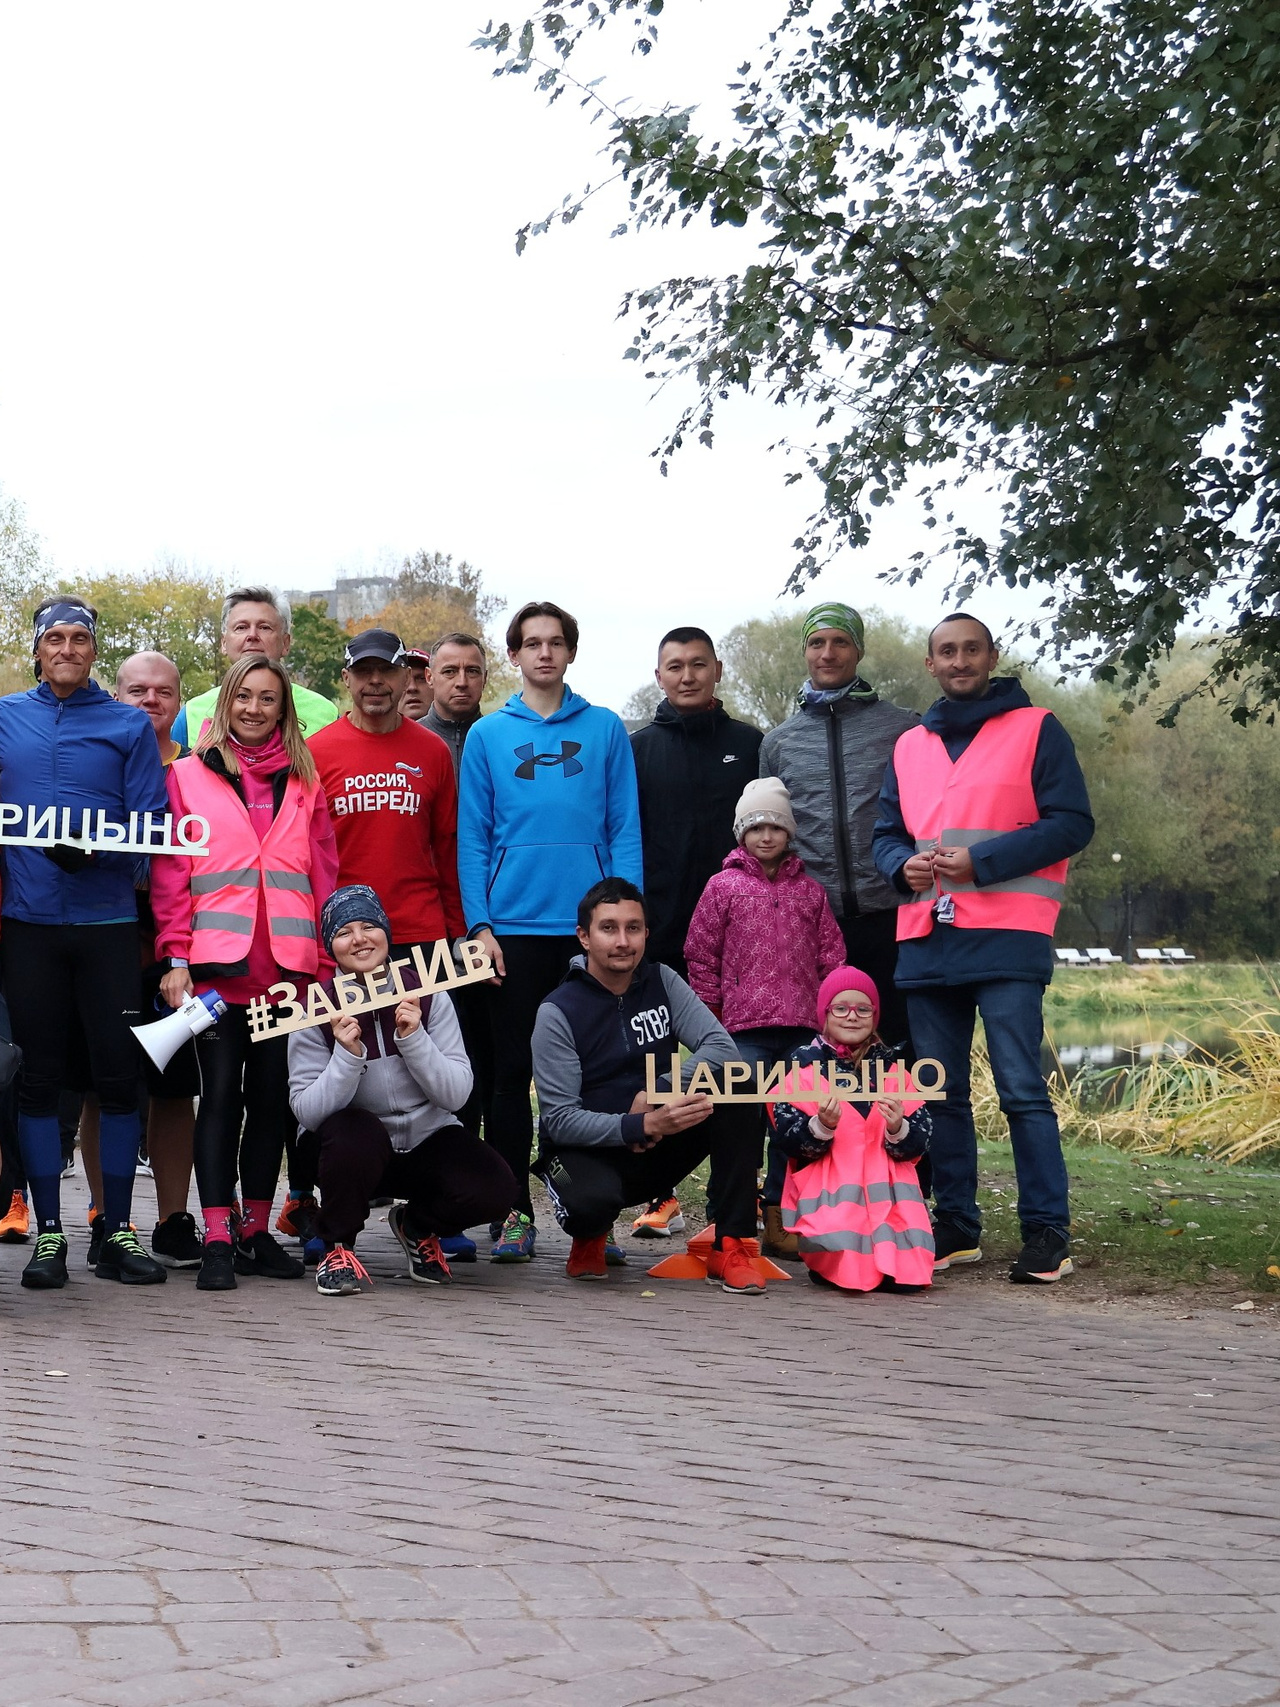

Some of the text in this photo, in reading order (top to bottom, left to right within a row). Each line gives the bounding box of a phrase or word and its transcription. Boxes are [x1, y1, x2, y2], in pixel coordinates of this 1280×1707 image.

[344, 773, 412, 792] РОССИЯ,
[334, 790, 421, 816] ВПЕРЕД!
[630, 1005, 670, 1046] ST82
[645, 1053, 947, 1101] ЦАРИЦЫНО
